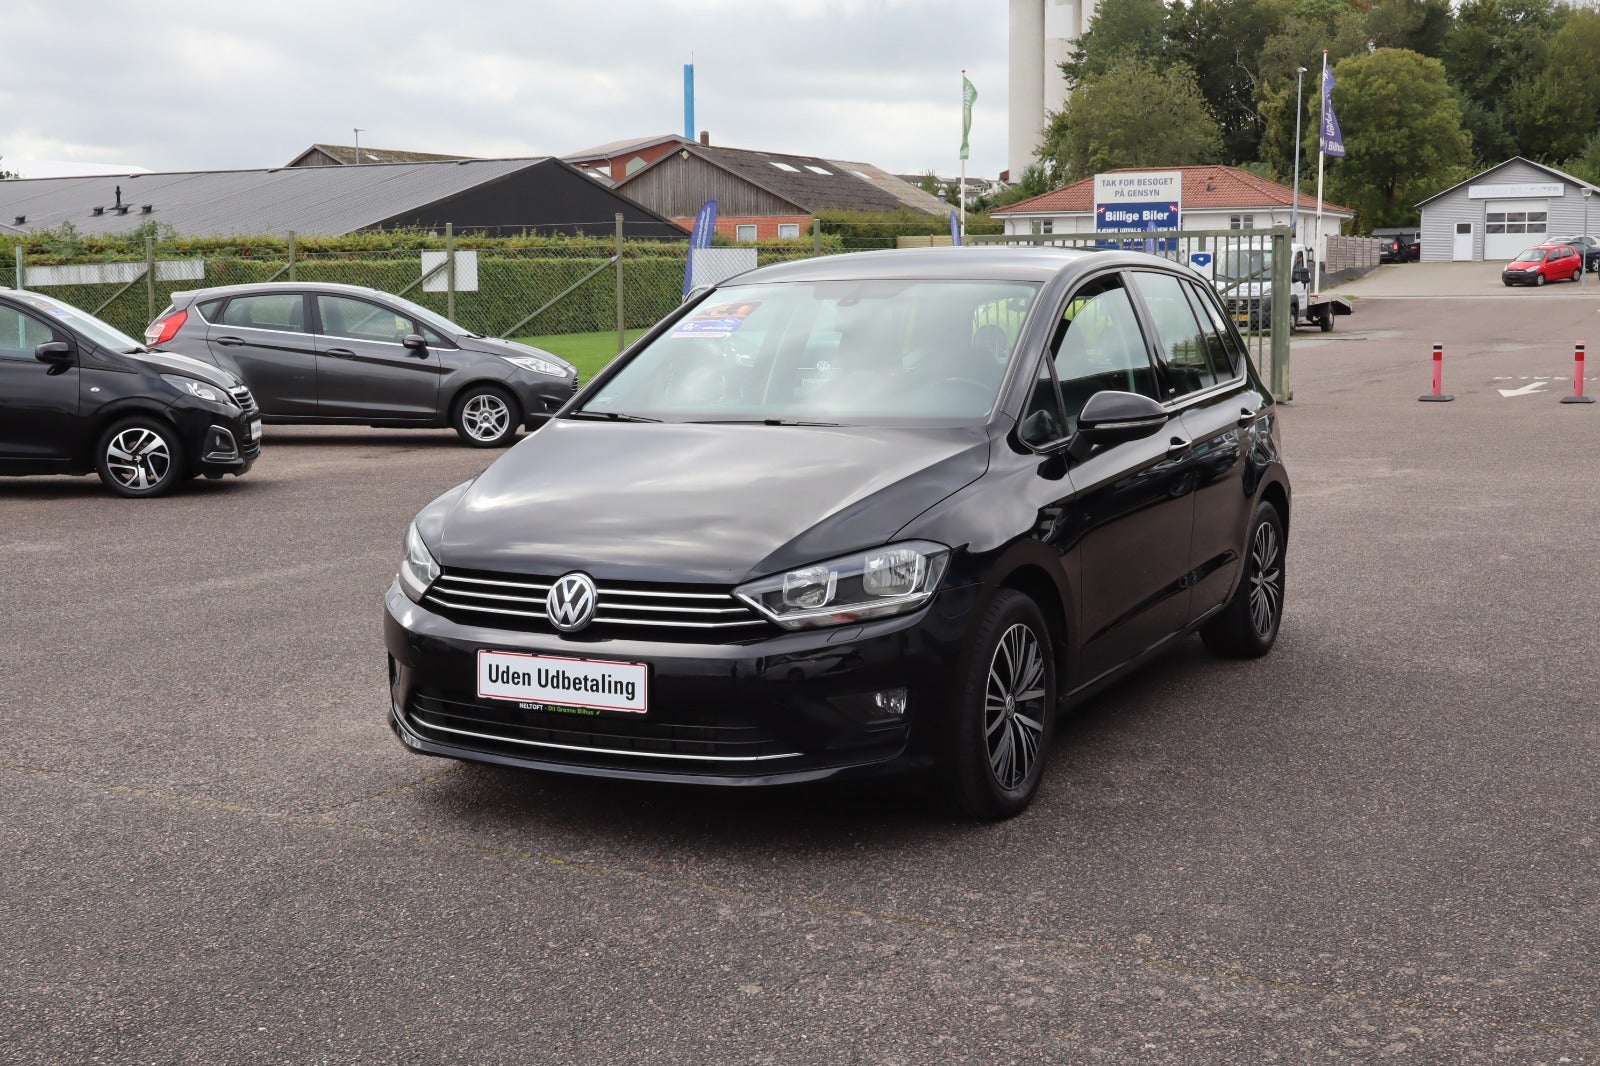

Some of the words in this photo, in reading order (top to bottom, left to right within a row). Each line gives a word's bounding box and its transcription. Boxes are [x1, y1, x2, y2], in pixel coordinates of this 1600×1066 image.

[1101, 179, 1117, 187] TAK
[1119, 178, 1135, 187] FOR
[1137, 177, 1174, 187] BESØGET
[1114, 189, 1125, 198] PÅ
[1127, 188, 1160, 198] GENSYN
[1105, 210, 1140, 223] Billige
[1142, 209, 1169, 221] Biler
[488, 663, 532, 687] Uden
[537, 667, 636, 701] Udbetaling
[519, 702, 544, 711] NELTOFT
